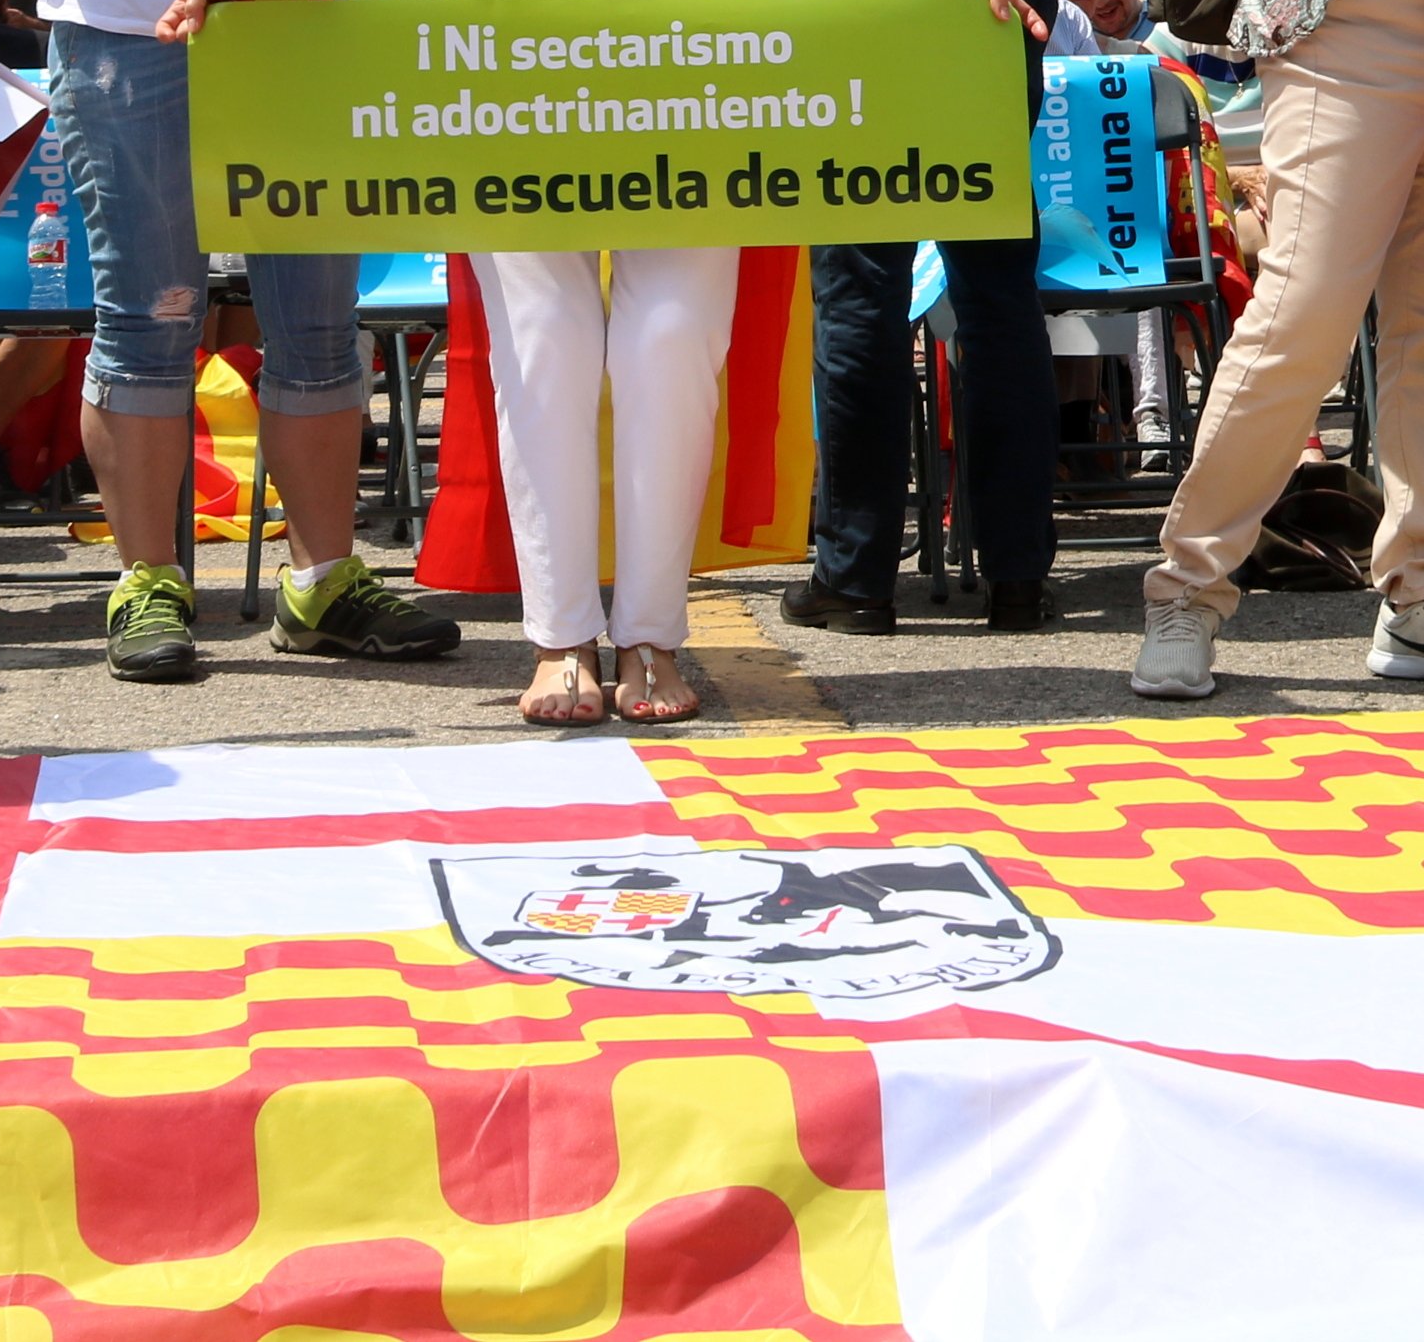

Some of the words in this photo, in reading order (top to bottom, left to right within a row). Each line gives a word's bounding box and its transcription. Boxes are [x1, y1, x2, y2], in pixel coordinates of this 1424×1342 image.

[444, 24, 498, 72] Ni
[510, 21, 793, 71] sectarismo
[351, 91, 399, 138] ni
[411, 83, 837, 138] adoctrinamiento
[849, 78, 864, 126] !
[226, 163, 328, 218] Por
[344, 176, 457, 217] una
[474, 153, 708, 216] escuela
[726, 151, 801, 209] de
[816, 146, 994, 206] todos
[1101, 111, 1135, 193] una
